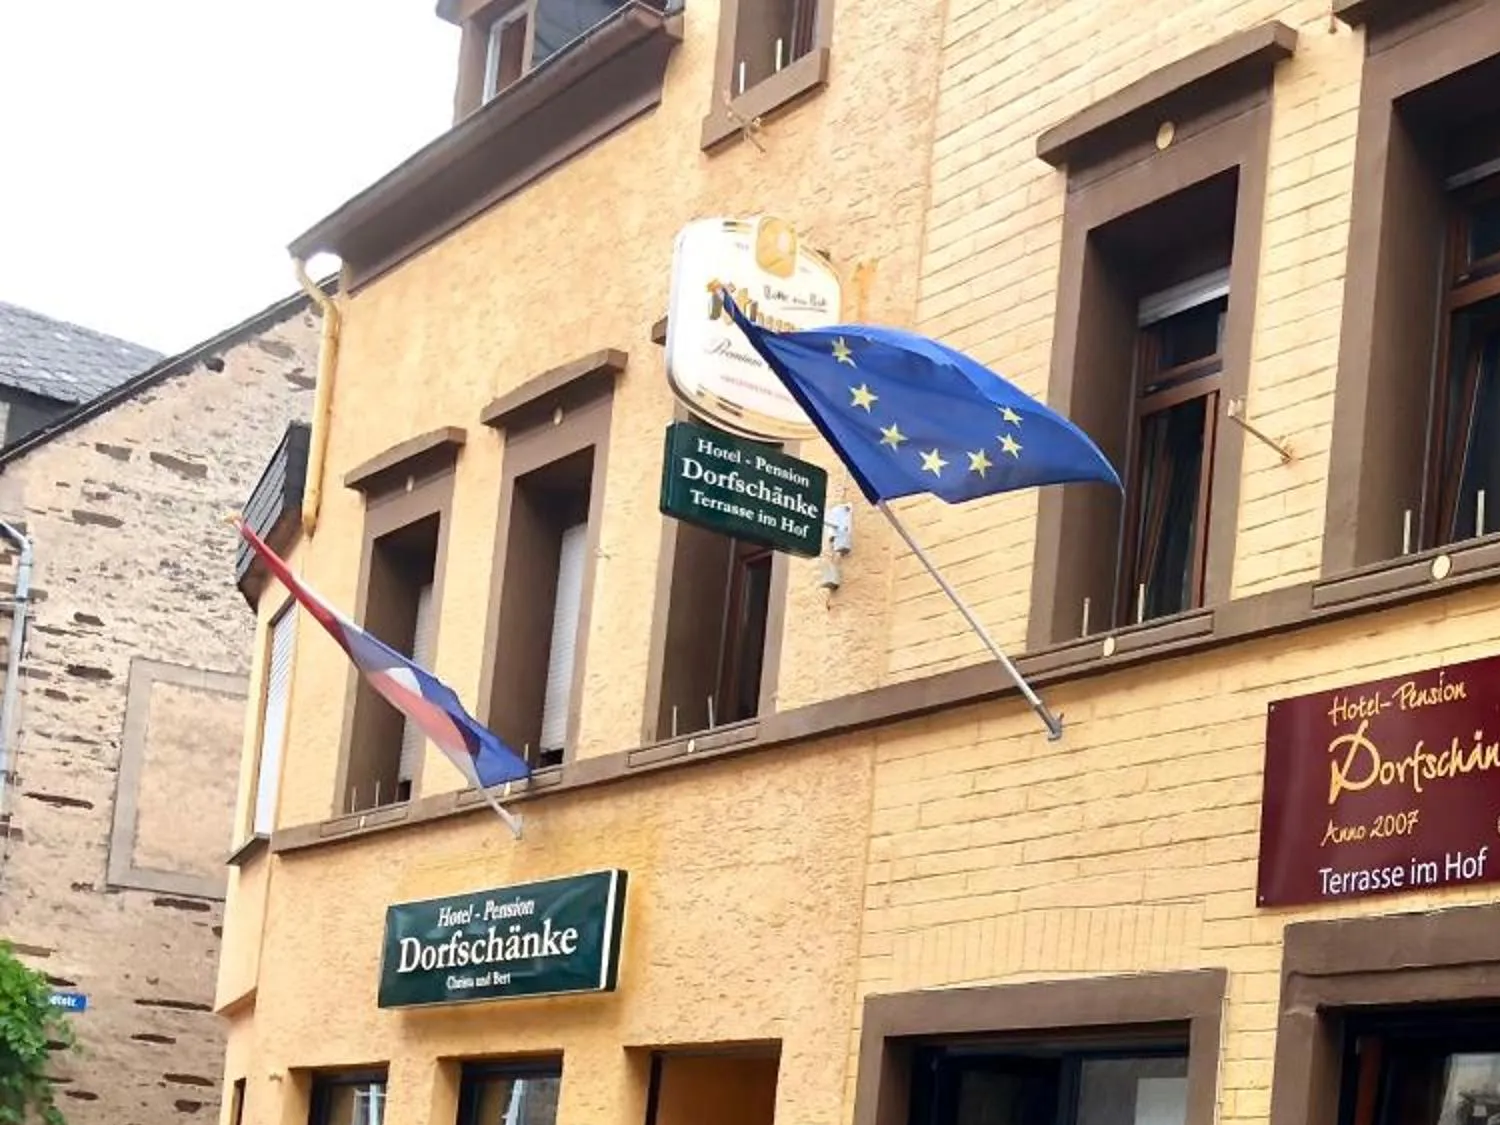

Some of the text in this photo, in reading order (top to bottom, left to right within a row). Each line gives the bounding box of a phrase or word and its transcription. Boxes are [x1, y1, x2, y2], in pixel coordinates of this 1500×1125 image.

[681, 456, 820, 520] Dorfschänke
[697, 438, 741, 464] Hotel
[754, 455, 810, 488] Pension
[689, 489, 809, 539] Terrasse im Hof
[1319, 809, 1420, 848] Anno 2007
[1318, 847, 1489, 896] Terrasse im Hof
[436, 904, 473, 928] Hotel
[483, 896, 536, 922] Pension
[396, 918, 580, 974] Dorfschänke
